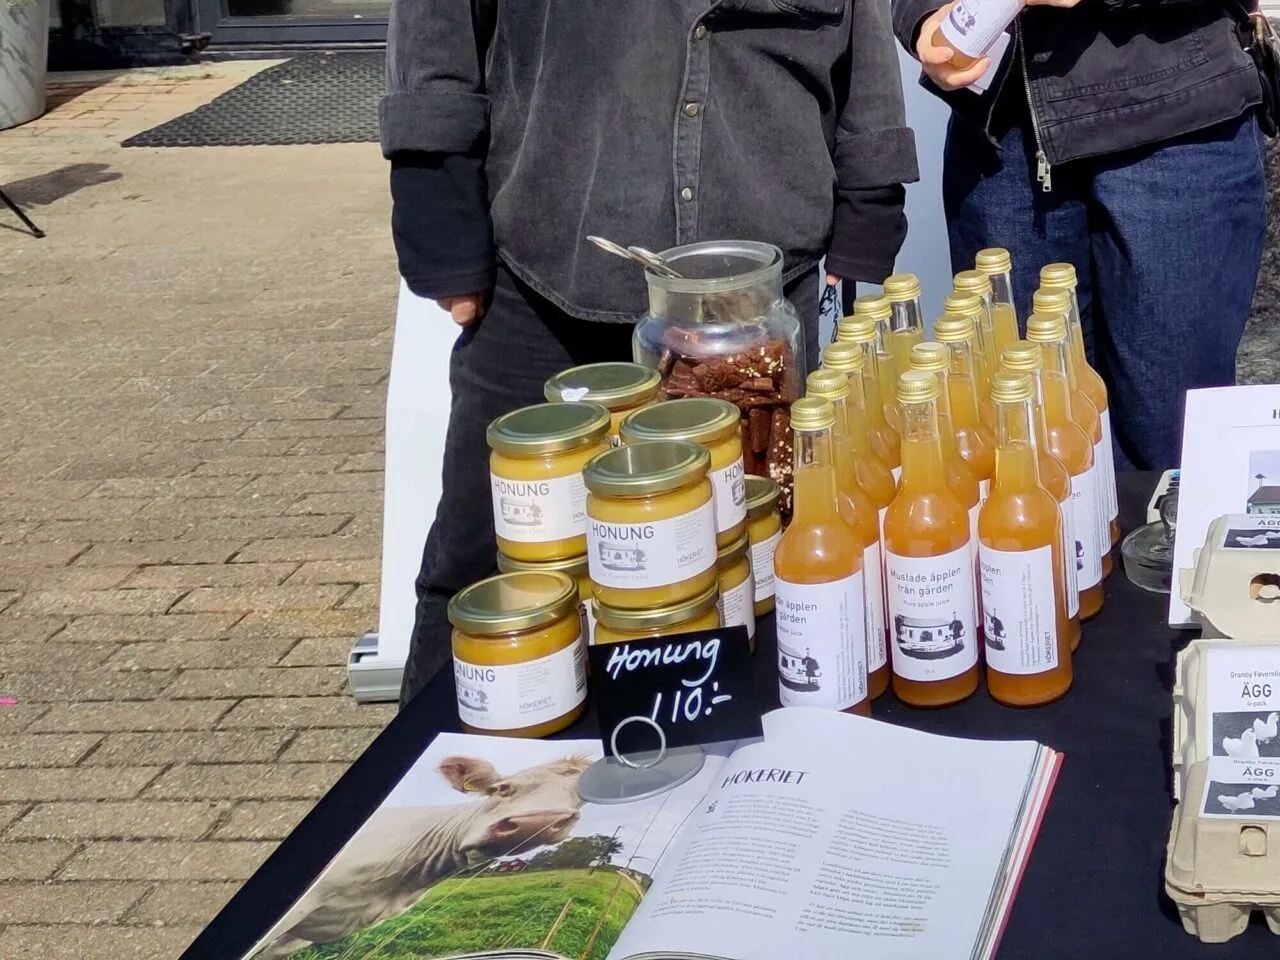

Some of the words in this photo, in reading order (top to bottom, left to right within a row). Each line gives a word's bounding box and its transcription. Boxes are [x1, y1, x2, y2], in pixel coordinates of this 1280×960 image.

[495, 481, 550, 497] HONUNG
[592, 524, 655, 540] HONUNG
[891, 568, 927, 583] Mustade
[930, 567, 961, 584] äpplen
[897, 584, 915, 595] från
[918, 583, 953, 597] gården
[785, 600, 818, 612] äpplen
[606, 638, 720, 687] Honung
[1241, 681, 1272, 698] ÄGG
[651, 682, 732, 723] 110:-
[1242, 766, 1275, 777] ÄGG
